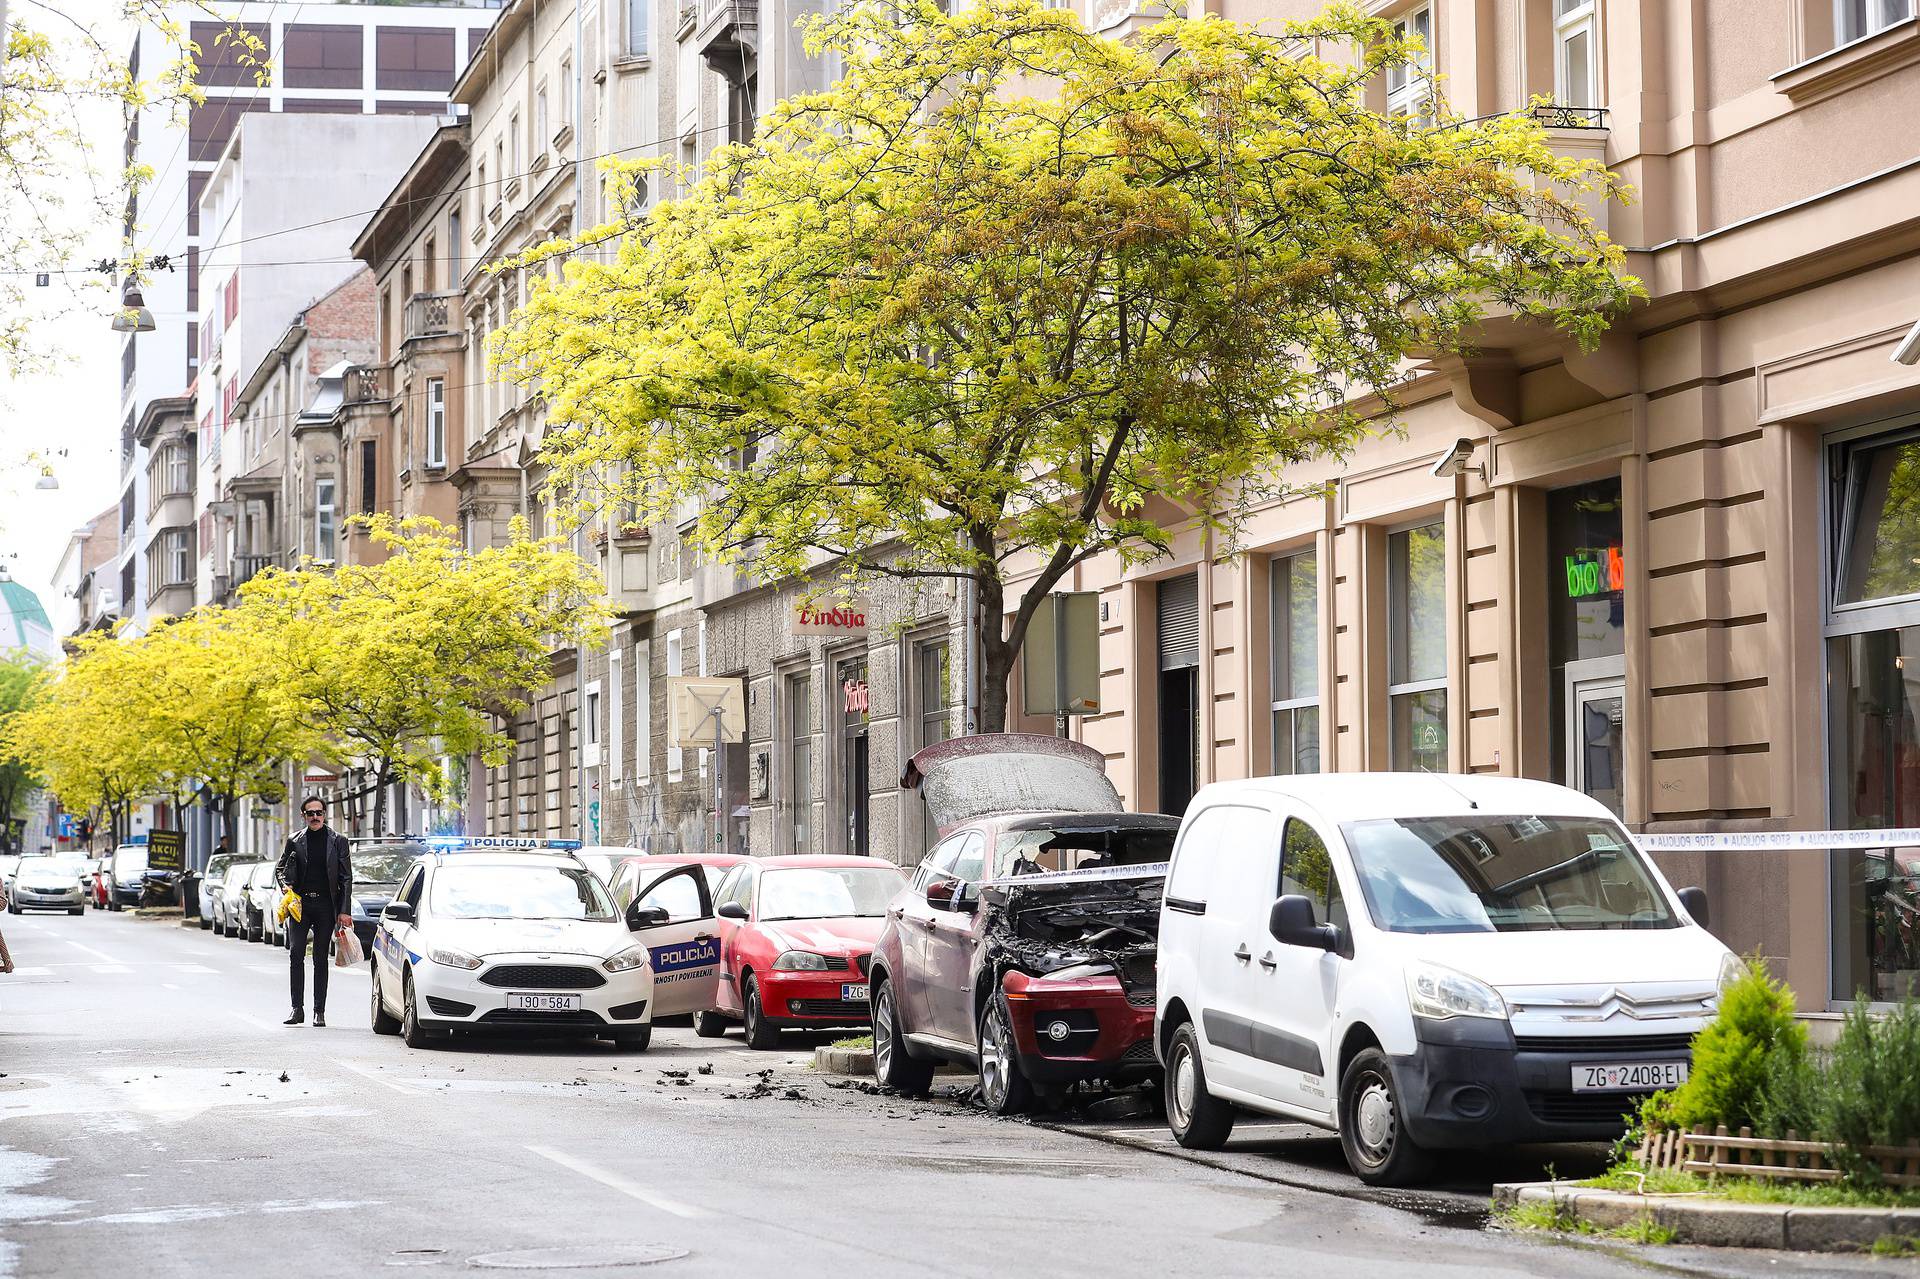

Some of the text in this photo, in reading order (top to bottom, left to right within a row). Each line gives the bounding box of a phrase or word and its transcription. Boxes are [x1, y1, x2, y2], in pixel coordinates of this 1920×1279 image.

[474, 838, 538, 848] POLICIJA
[660, 946, 716, 966] POLICIJA
[850, 986, 864, 999] ZG
[519, 996, 571, 1009] 190 584
[1585, 1067, 1607, 1087] ZG
